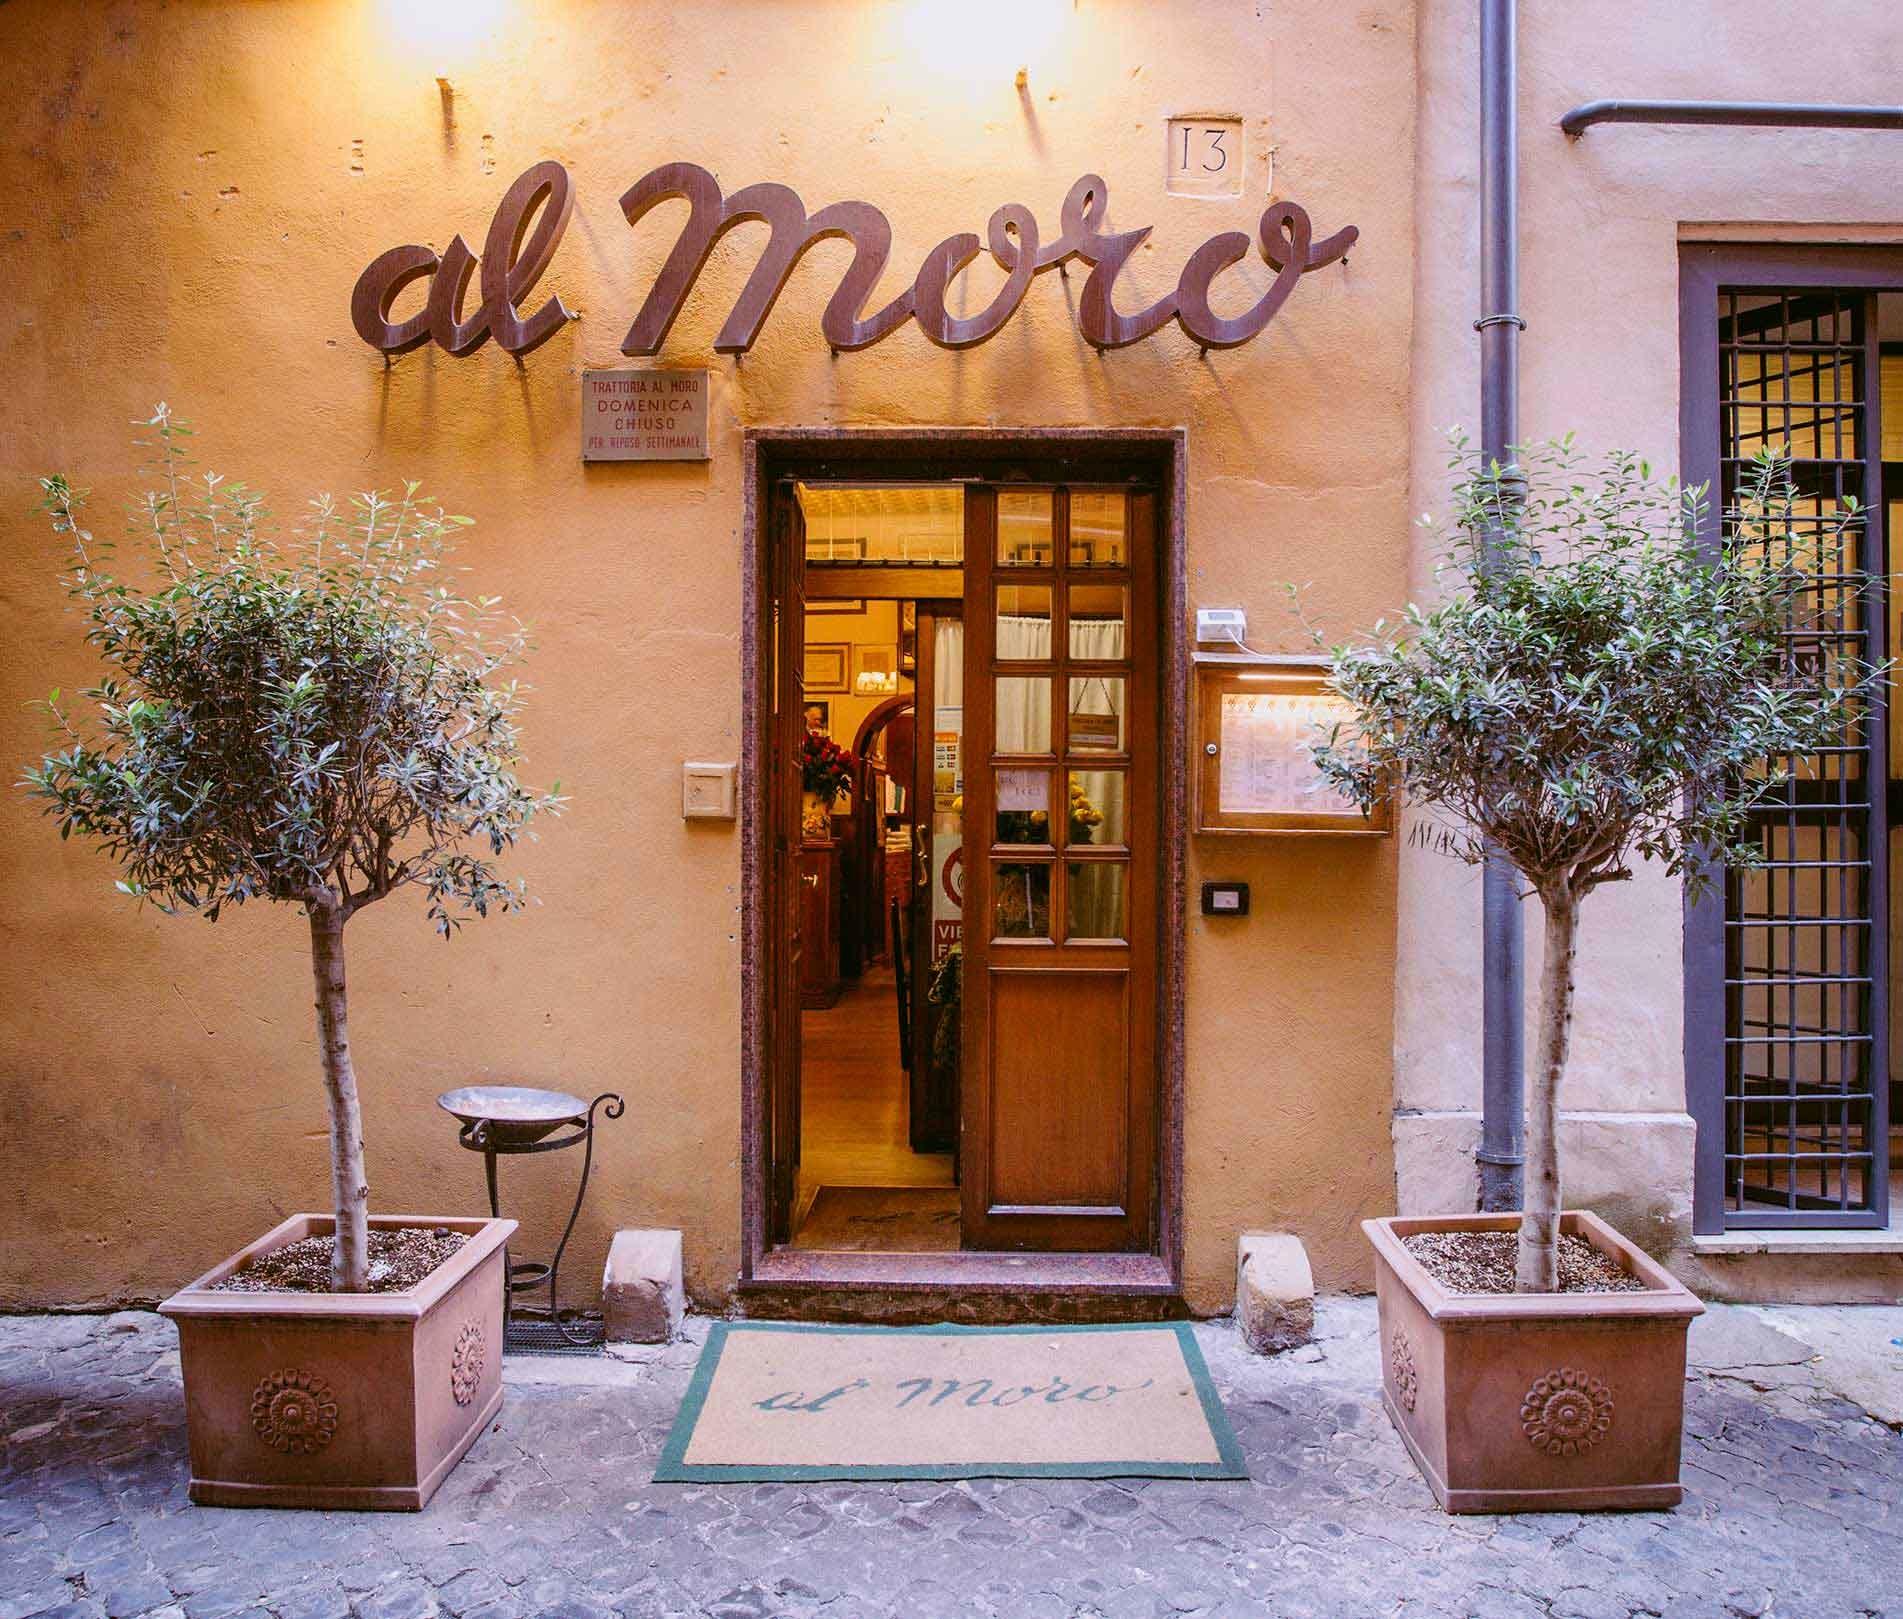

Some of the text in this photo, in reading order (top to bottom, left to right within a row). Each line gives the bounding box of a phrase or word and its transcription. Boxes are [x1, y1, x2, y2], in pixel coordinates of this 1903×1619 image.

[1180, 127, 1226, 172] 13
[351, 160, 580, 357] al
[592, 380, 698, 393] TRATTORIA AL MORO
[597, 399, 693, 413] DOMENICA
[615, 417, 675, 430] CHIUSO
[588, 436, 603, 448] PER
[609, 436, 640, 449] RIPOSO
[752, 1378, 870, 1413] al
